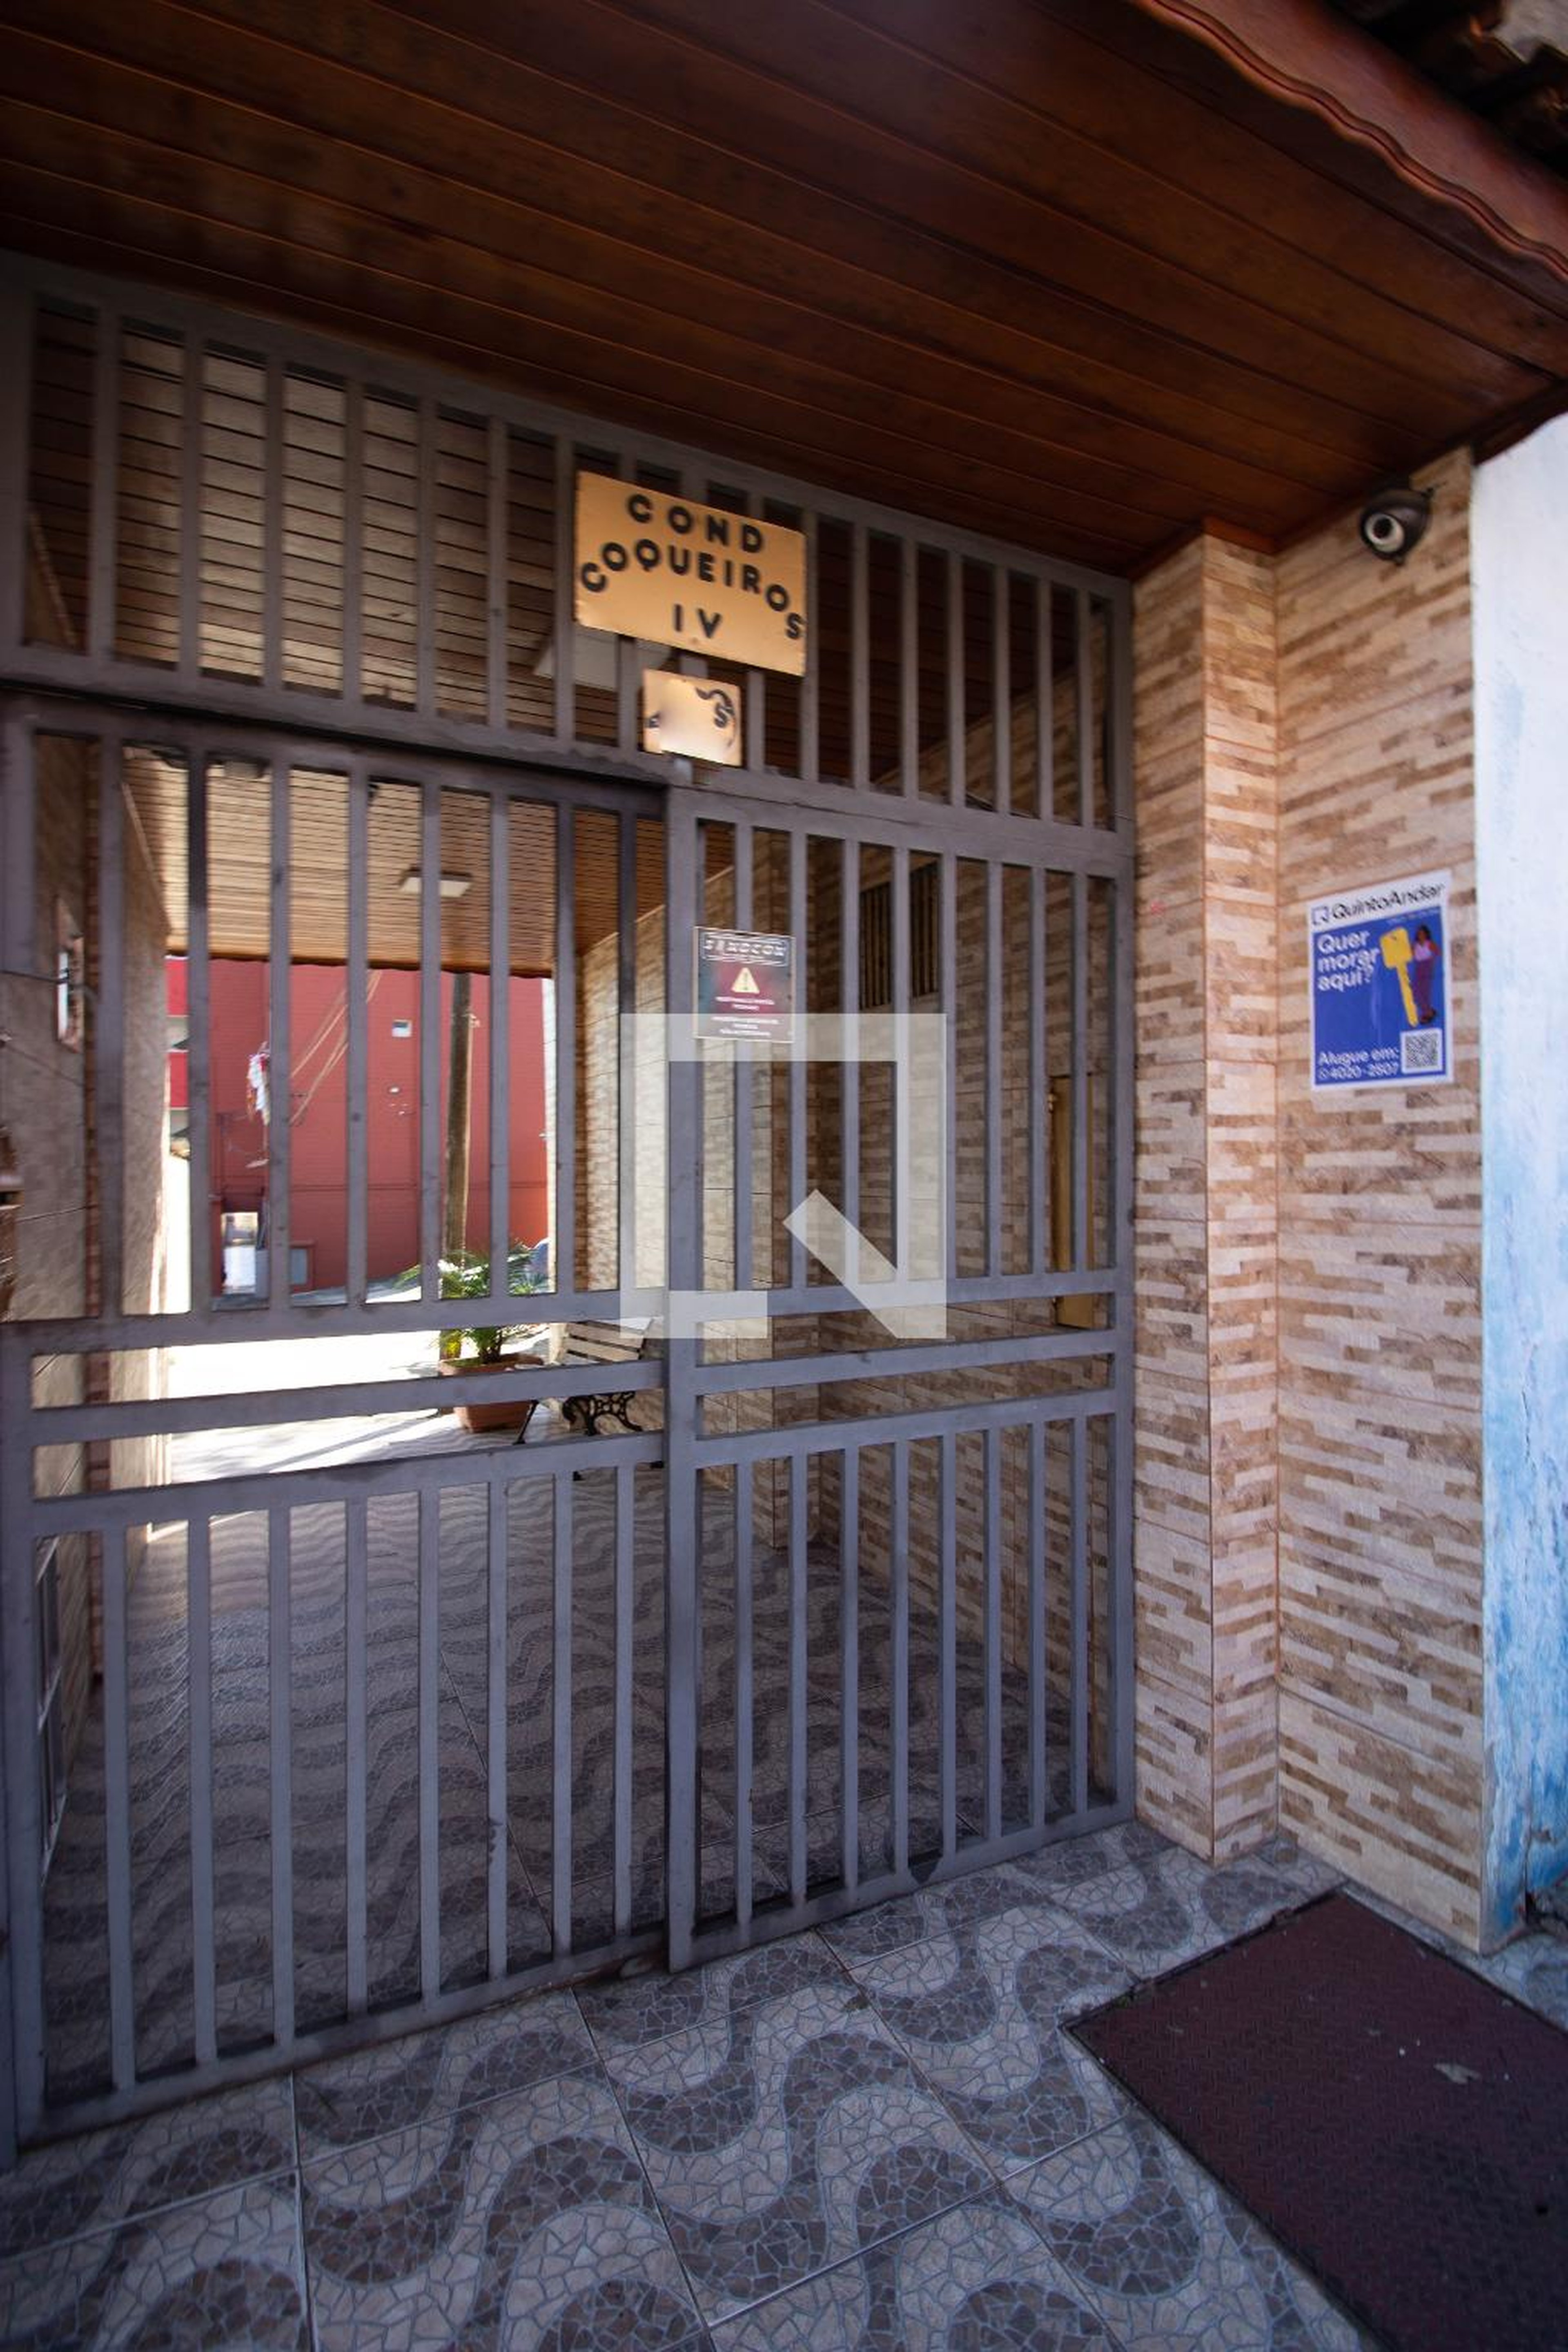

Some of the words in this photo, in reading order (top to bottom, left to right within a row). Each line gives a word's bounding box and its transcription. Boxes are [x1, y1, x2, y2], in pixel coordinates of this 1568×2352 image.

[628, 494, 763, 553] COND
[581, 539, 806, 640] COQUEIROS
[674, 604, 721, 638] IV
[1318, 931, 1370, 954] Quer
[1318, 948, 1380, 973] morar
[1318, 965, 1374, 992] aqui?
